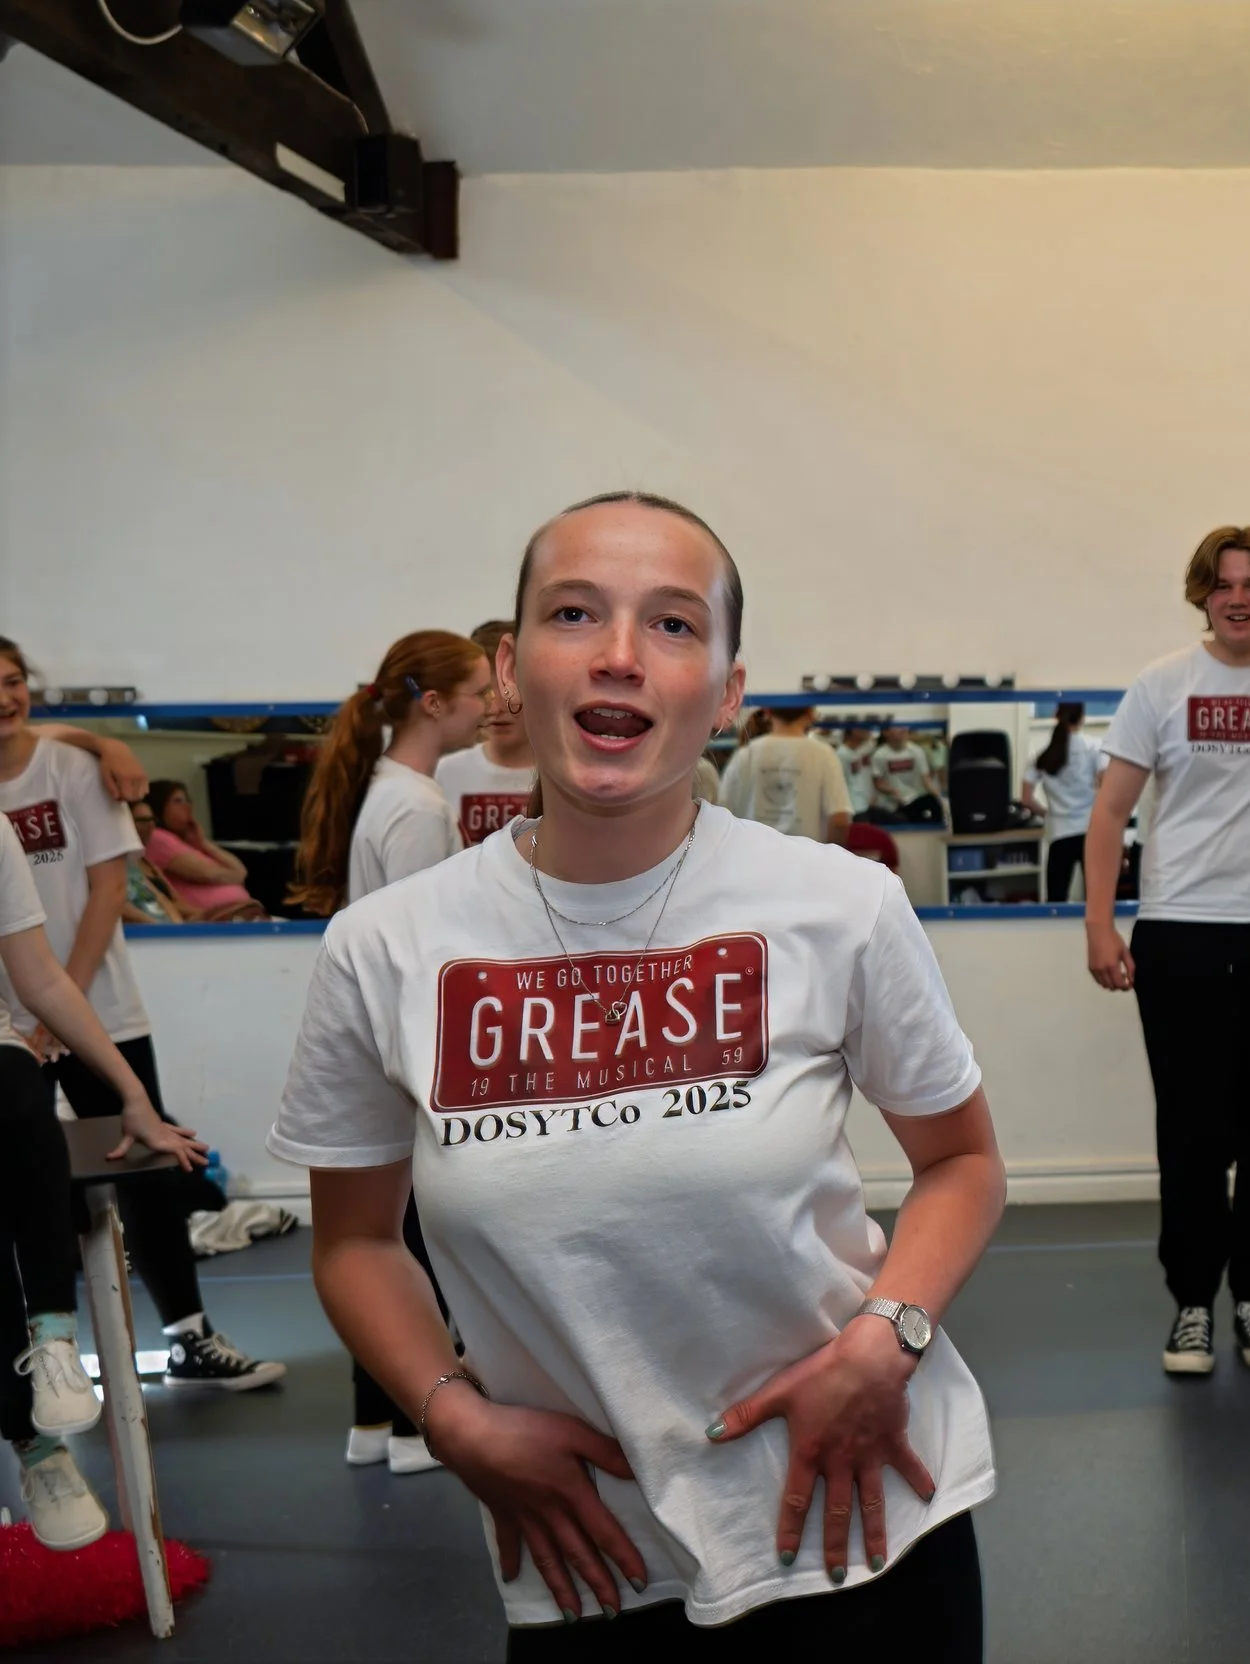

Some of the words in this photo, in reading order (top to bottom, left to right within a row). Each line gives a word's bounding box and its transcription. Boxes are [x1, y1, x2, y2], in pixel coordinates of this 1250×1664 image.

[516, 970, 545, 991] WE
[557, 967, 581, 988] GO
[594, 954, 693, 985] TOGETHER
[469, 973, 742, 1068] GREASE
[471, 1077, 490, 1097] 19
[509, 1072, 555, 1092] THE
[577, 1054, 692, 1089] MUSICAL
[721, 1046, 743, 1066] 59
[441, 1100, 641, 1147] DOSYTCo
[662, 1080, 752, 1119] 2025
